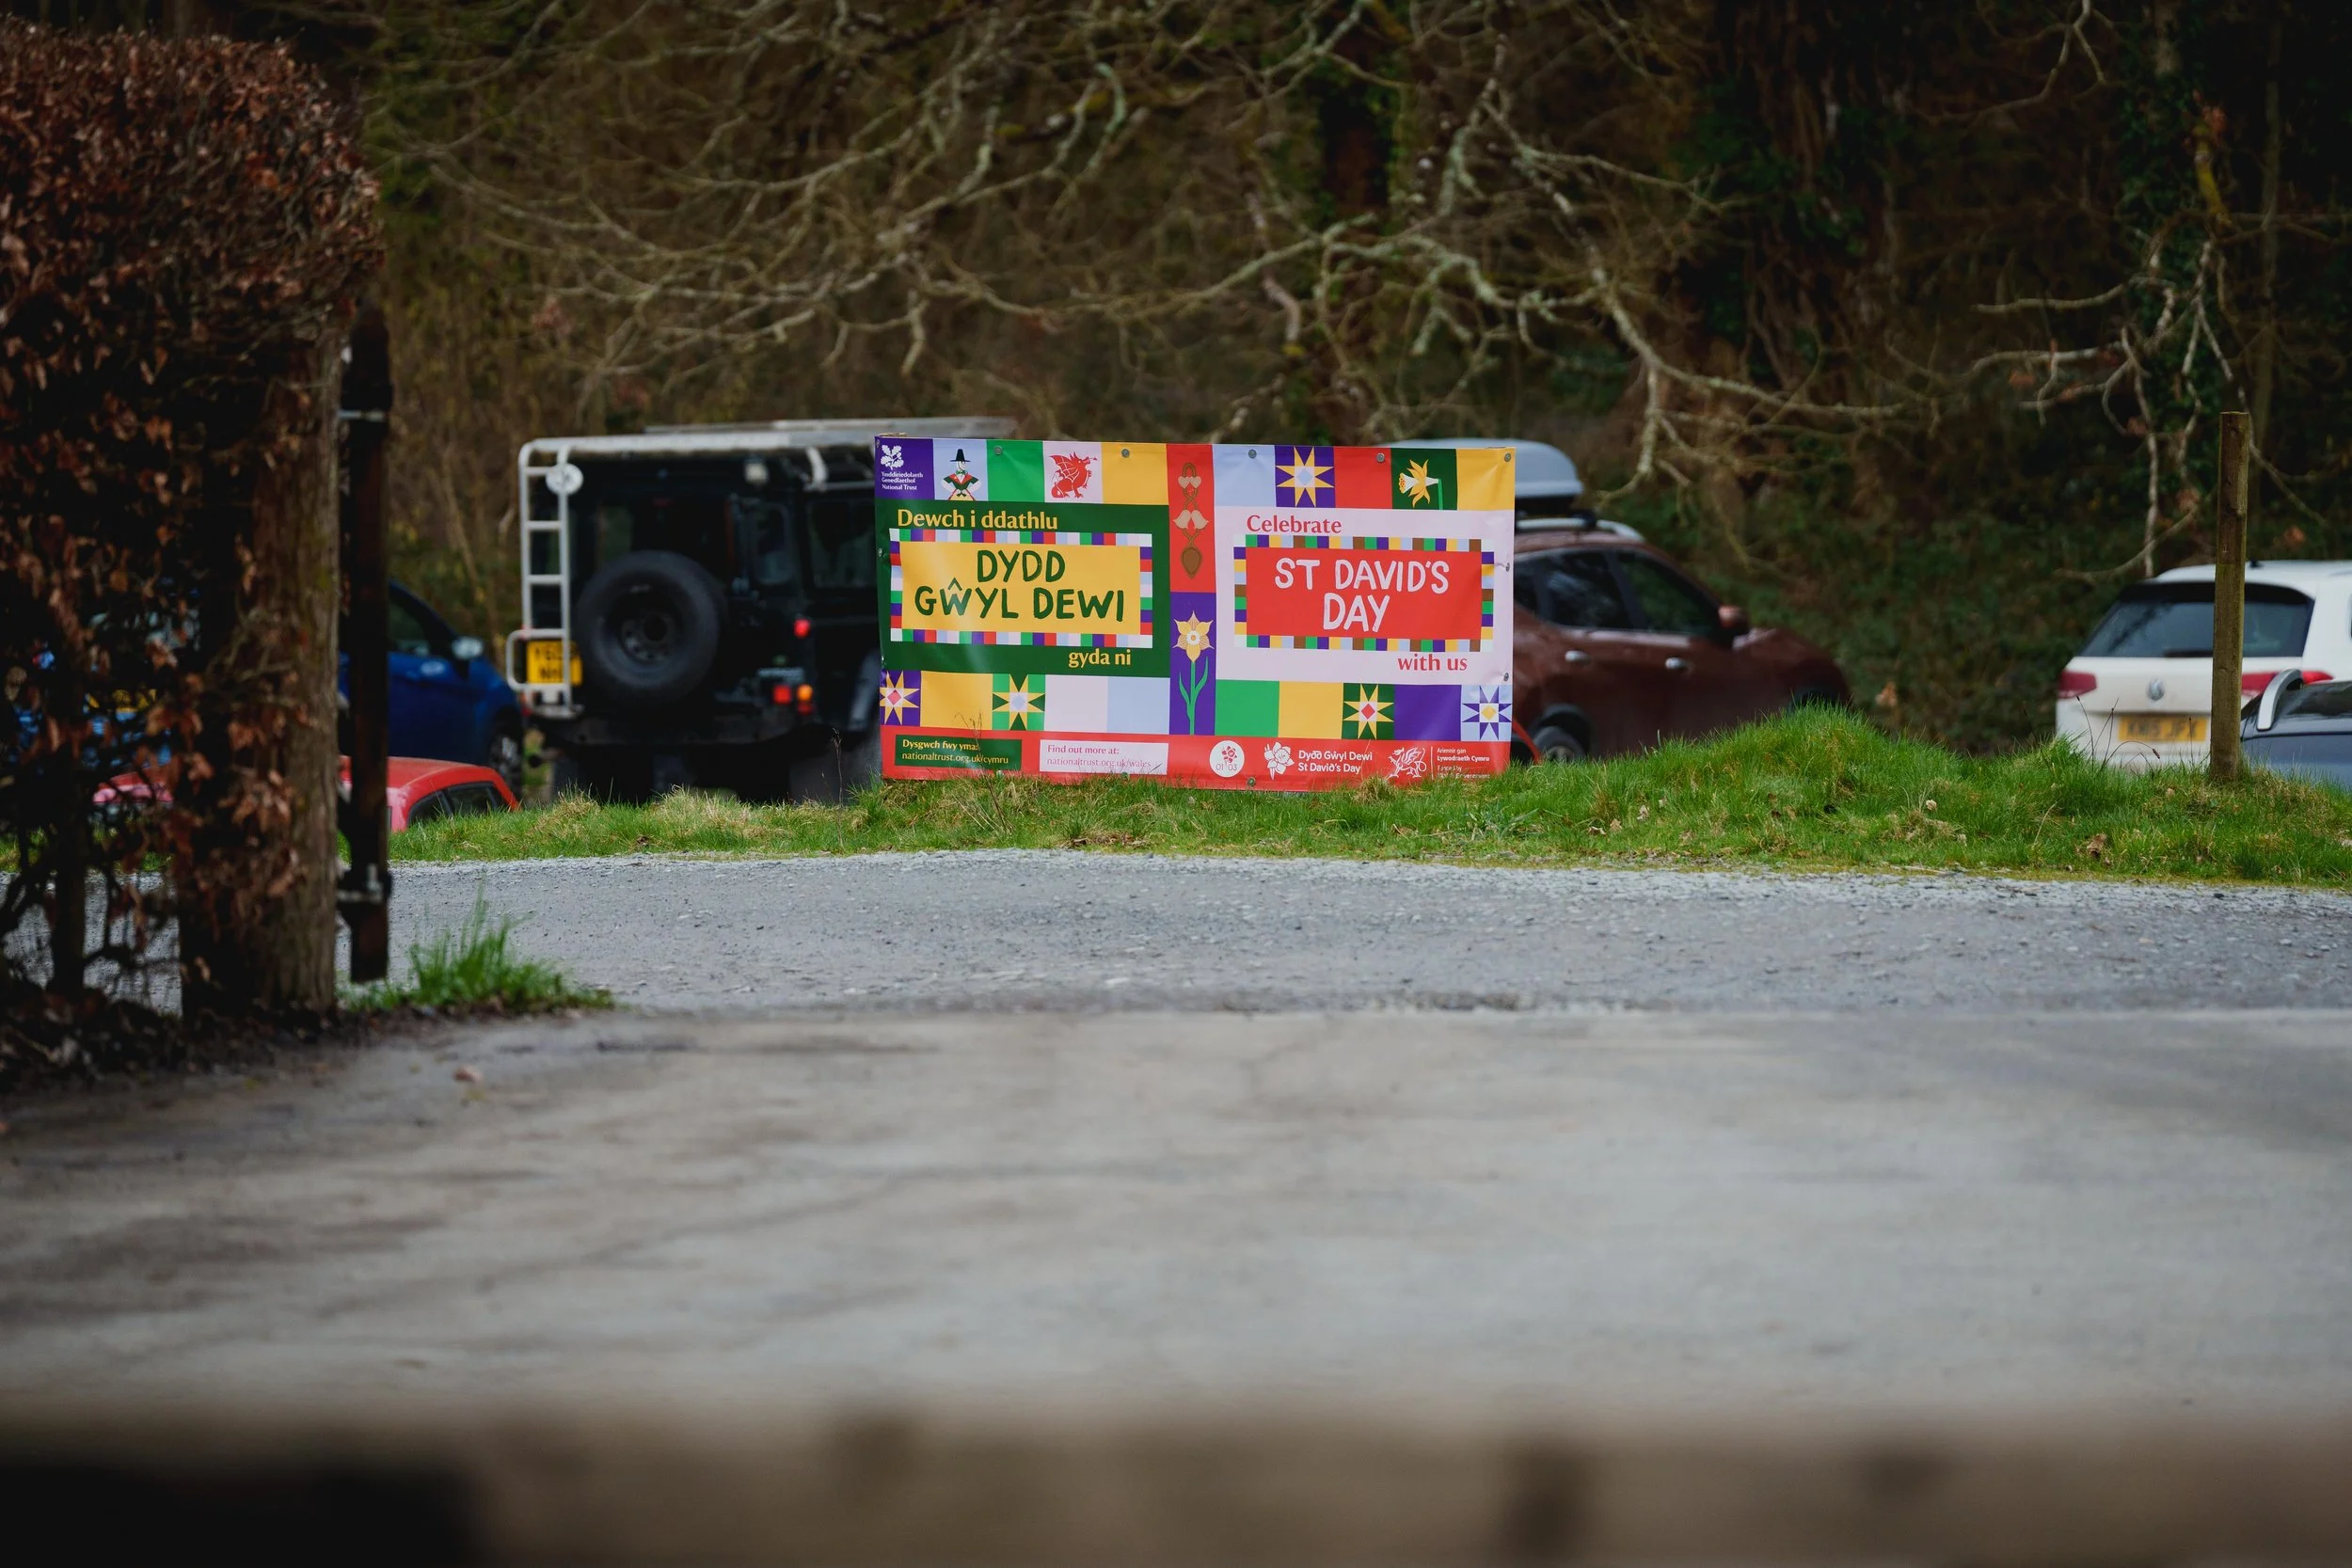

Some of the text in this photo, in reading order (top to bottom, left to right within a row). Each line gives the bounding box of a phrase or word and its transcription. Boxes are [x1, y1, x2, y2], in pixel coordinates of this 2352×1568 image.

[898, 509, 1058, 530] Dewch i ddathlu
[1247, 515, 1343, 534] Celebrate
[977, 549, 1066, 583] DYDD
[1274, 557, 1450, 594] ST DAVID'S
[914, 577, 1124, 623] GŴYL DEWI
[1323, 593, 1391, 633] DAY
[1068, 648, 1131, 669] gyda ni
[1398, 653, 1468, 672] with us
[902, 738, 978, 752] Dysgwch fwy yma:
[1047, 744, 1066, 753] Find
[1068, 746, 1083, 754] out
[902, 752, 1009, 765] nationaltrust.org.uk/cymru
[1046, 757, 1152, 768] nationaltrust.org.uk/wales
[1349, 752, 1373, 761] Dewi
[1297, 762, 1308, 771] St
[1343, 764, 1361, 775] Day
